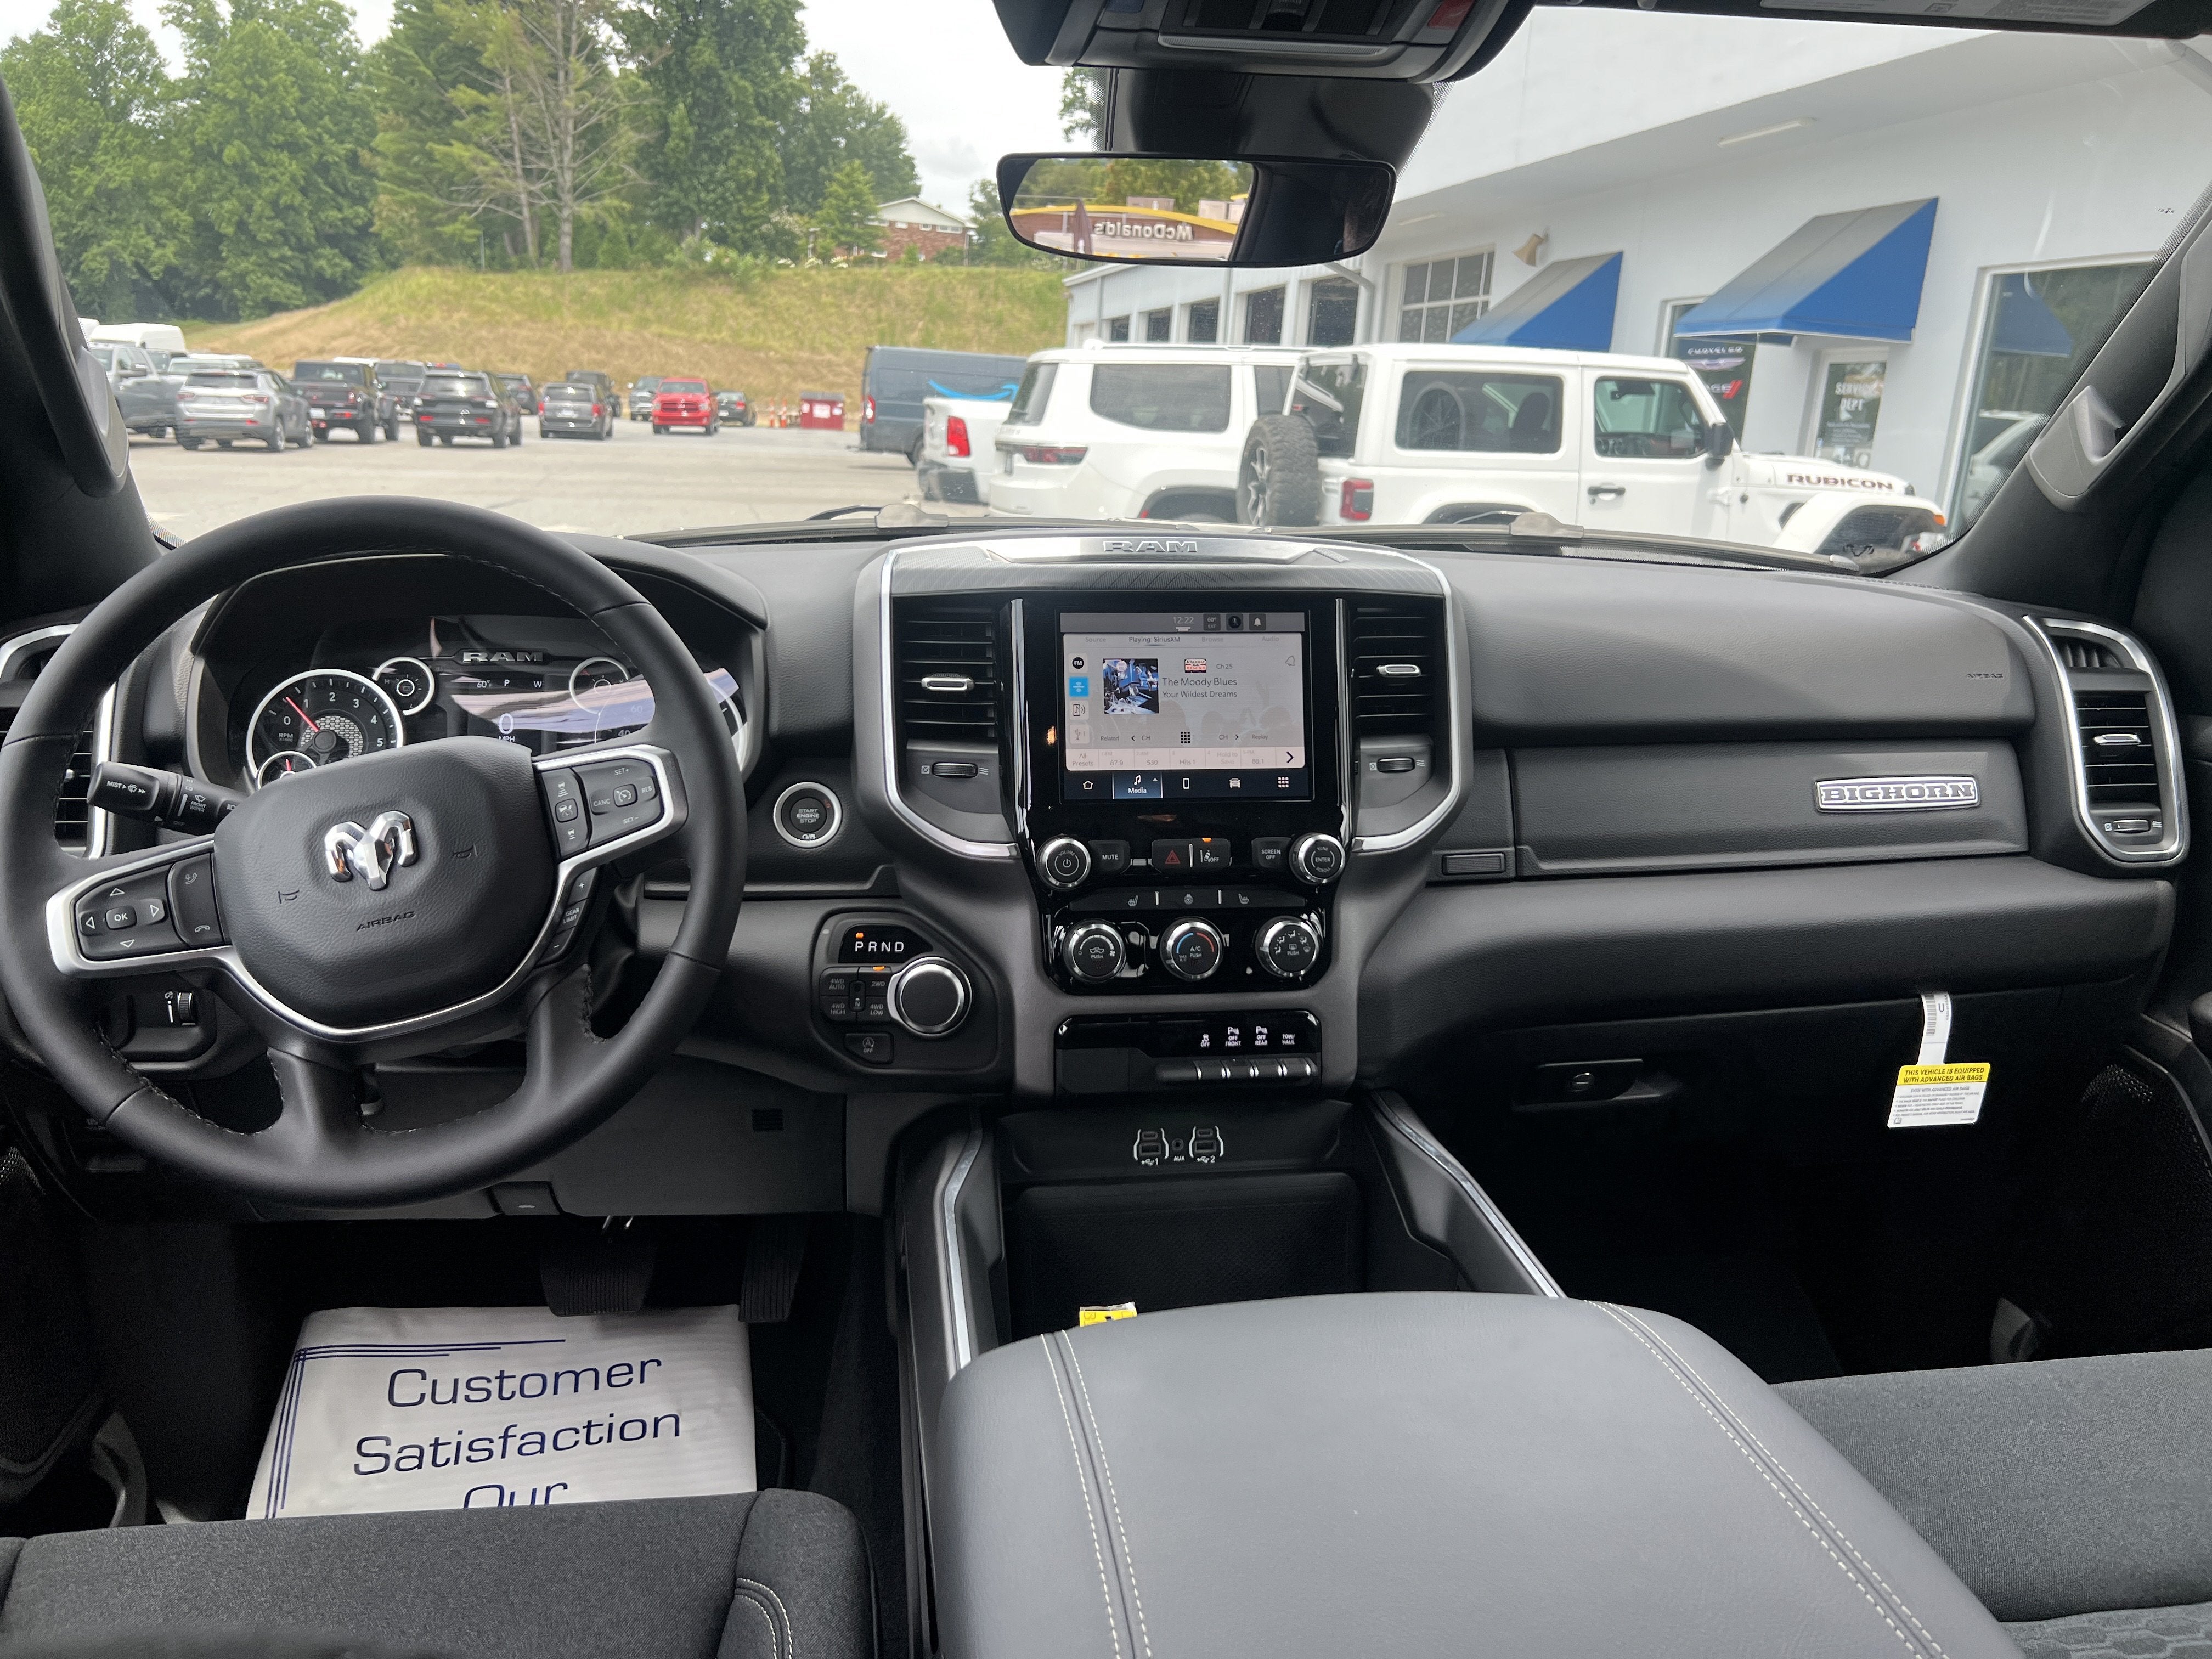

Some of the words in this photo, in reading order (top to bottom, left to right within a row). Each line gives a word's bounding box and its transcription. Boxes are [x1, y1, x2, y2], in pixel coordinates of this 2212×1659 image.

[1787, 474, 1893, 490] RUBICON
[1103, 541, 1198, 553] RAM
[462, 652, 543, 662] RAM
[1181, 678, 1211, 687] Moody
[1214, 678, 1237, 686] Blues
[329, 692, 336, 702] 2
[303, 699, 308, 708] 1
[353, 699, 359, 708] 3
[283, 716, 291, 725] 0
[370, 715, 377, 724] 4
[499, 713, 514, 734] 0
[377, 738, 383, 747] 5
[106, 780, 122, 789] MIST
[1822, 783, 1974, 803] BIGHORN
[594, 798, 611, 806] CANC
[114, 912, 128, 922] OK
[566, 907, 580, 917] GEAR
[356, 911, 416, 932] AIRBAG
[855, 941, 863, 952] P
[868, 941, 877, 952] R
[881, 941, 891, 952] N
[895, 941, 904, 952] D
[387, 1358, 662, 1407] Customer
[353, 1412, 681, 1476] Satisfaction
